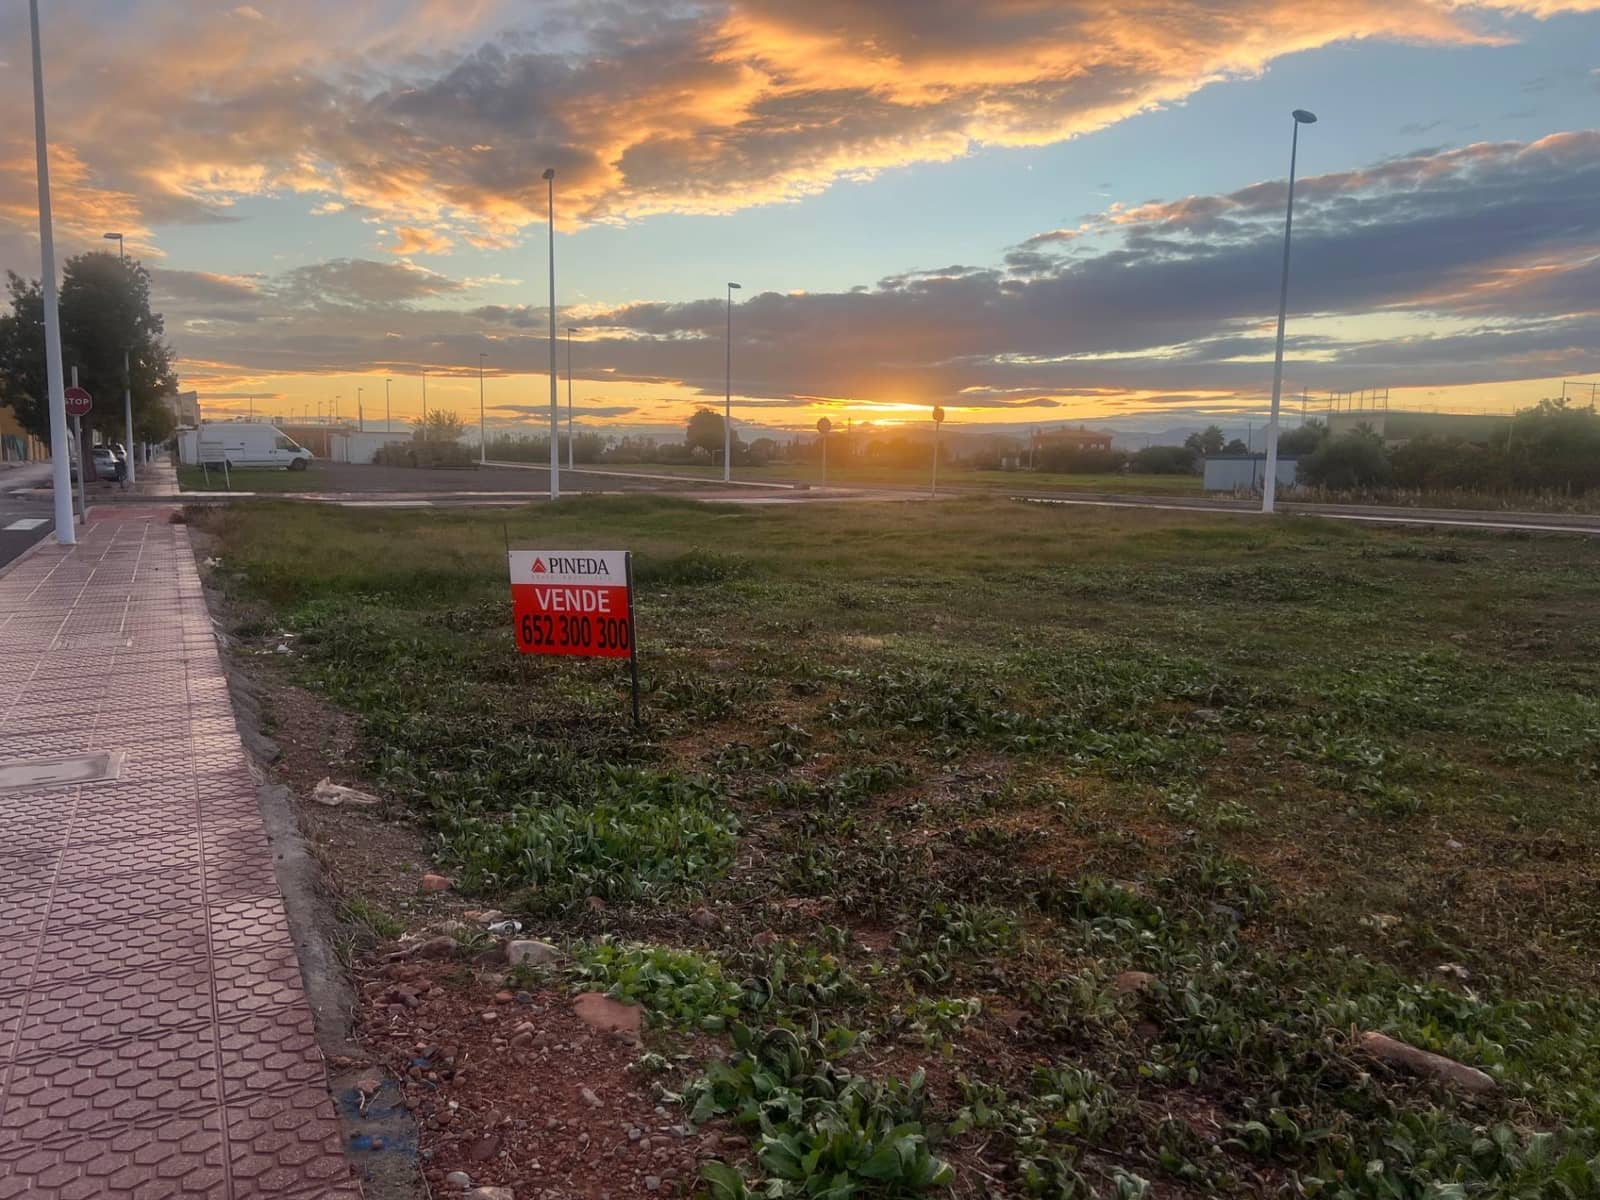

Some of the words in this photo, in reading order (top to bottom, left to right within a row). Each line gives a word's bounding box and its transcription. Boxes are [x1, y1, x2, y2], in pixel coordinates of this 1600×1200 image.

[549, 557, 609, 575] PINEDA
[535, 588, 611, 612] VENDE
[521, 615, 555, 646] 652
[558, 616, 591, 647] 300
[597, 617, 628, 649] 300
